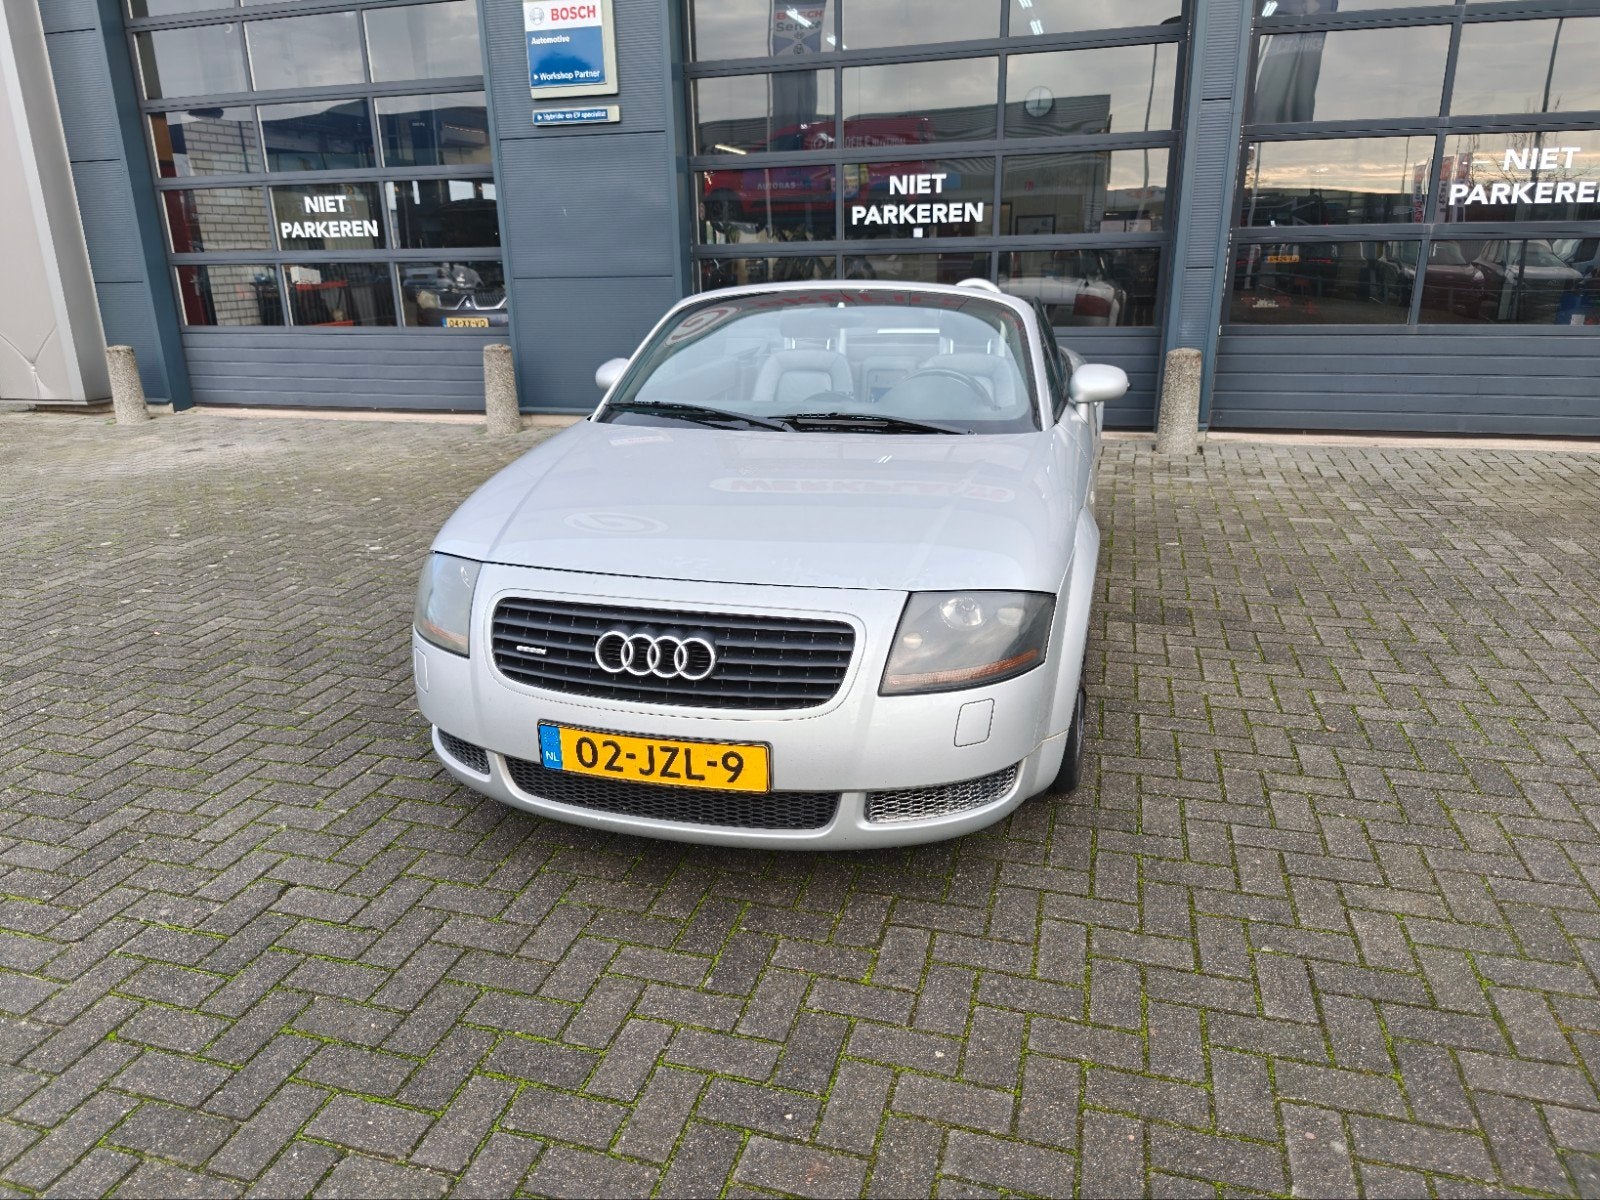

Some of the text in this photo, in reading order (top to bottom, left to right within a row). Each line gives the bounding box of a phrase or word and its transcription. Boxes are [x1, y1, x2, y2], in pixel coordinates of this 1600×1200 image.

[551, 5, 596, 21] BOSCH
[531, 35, 570, 45] Automotive
[540, 70, 600, 81] Workshop Partner
[1503, 146, 1581, 171] NIET
[889, 173, 947, 195] NIET
[1449, 182, 1600, 205] PARKERE
[304, 195, 346, 213] NIET
[852, 202, 984, 225] PARKEREN
[281, 220, 379, 238] PARKEREN
[545, 736, 744, 783] NL 02-JZL-9
